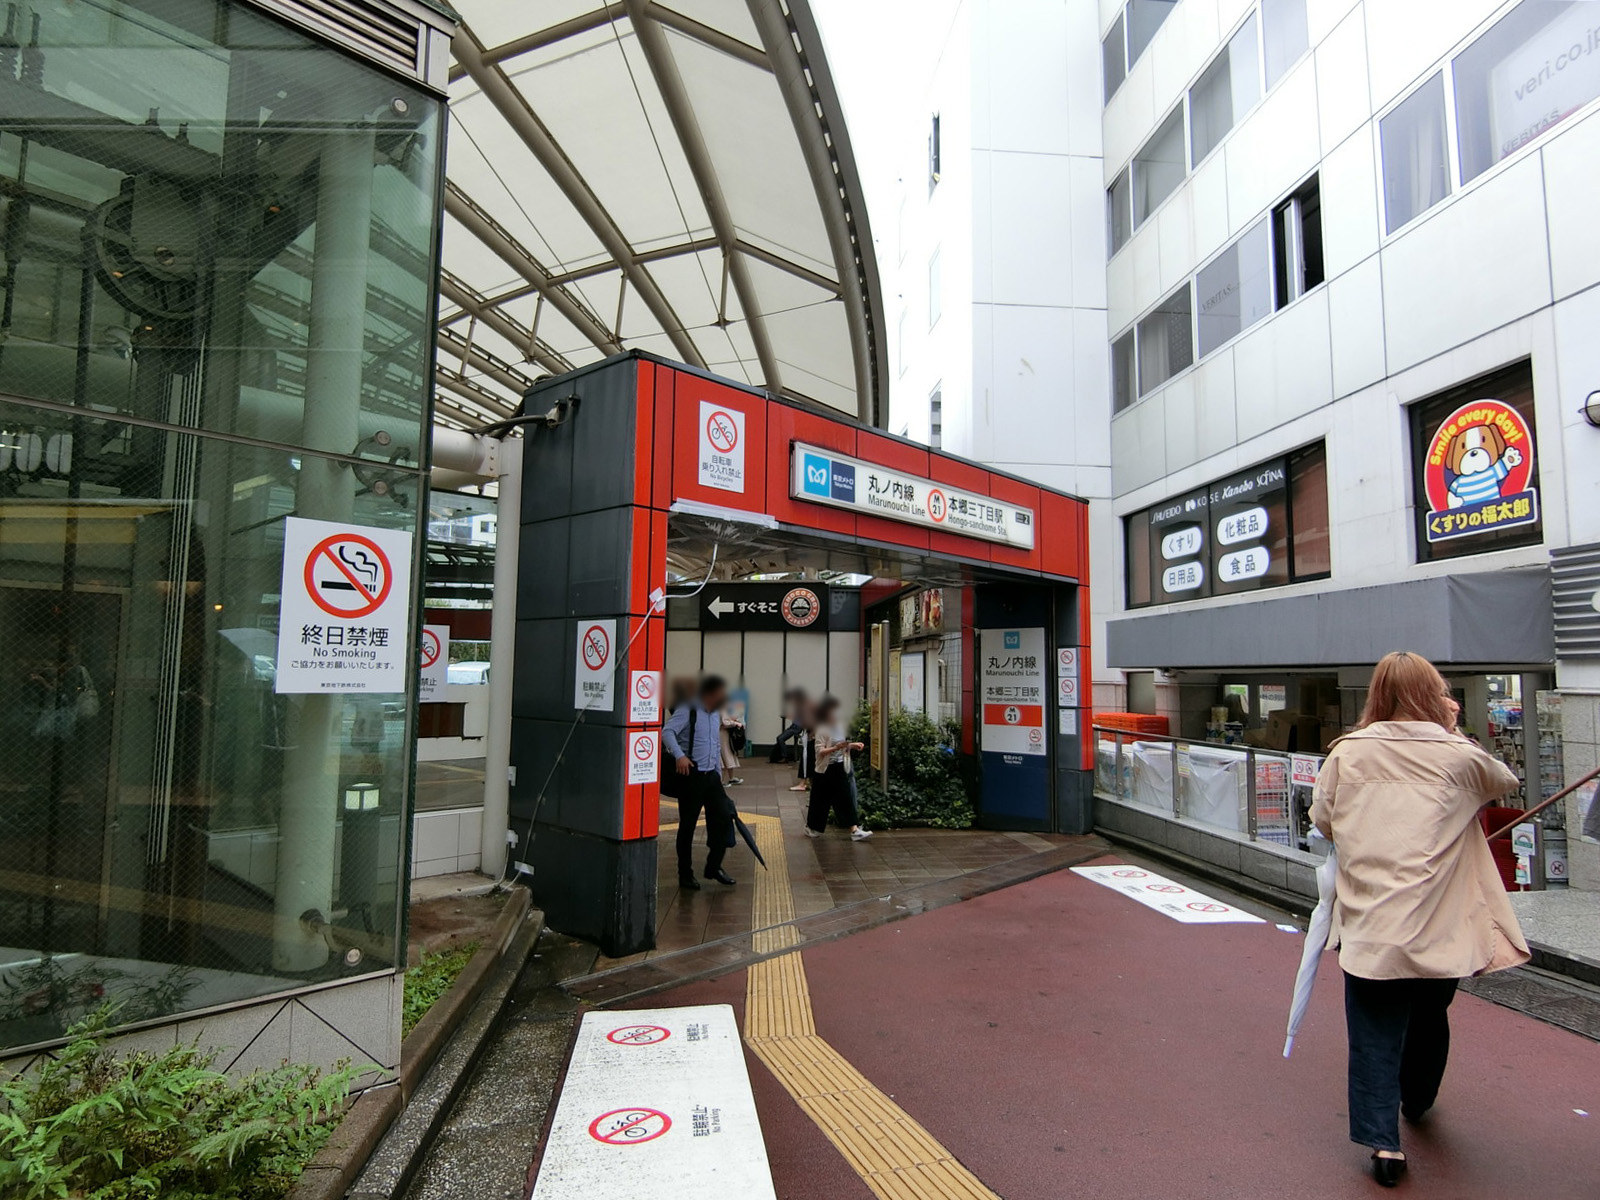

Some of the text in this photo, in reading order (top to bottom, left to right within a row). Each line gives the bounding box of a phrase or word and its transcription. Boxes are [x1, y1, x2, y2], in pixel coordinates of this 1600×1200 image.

[1502, 109, 1561, 155] VERITAS
[1430, 408, 1523, 466] Smile every day!
[712, 455, 732, 466] 自転車
[833, 474, 854, 485] 東京メトロ
[868, 474, 915, 501] 丸ノ内線
[868, 494, 926, 517] Marunouchi Line
[933, 494, 940, 504] M
[1151, 505, 1181, 524] SHISEIDO
[1222, 480, 1253, 500] Kanebo
[1256, 468, 1283, 488] SOFINA
[932, 505, 941, 515] 21
[948, 496, 1003, 524] 本郷三丁目駅
[1024, 515, 1028, 523] 2
[1430, 498, 1530, 534] くすりの福太郎
[948, 513, 996, 533] Hongo-sanchome
[1225, 514, 1259, 538] 化粧品
[1168, 533, 1194, 553] くすり
[1230, 554, 1255, 576] 食品
[1169, 567, 1195, 587] 日用品
[737, 602, 778, 613] すぐそこ
[301, 624, 389, 647] 終日禁煙
[313, 648, 376, 660] No Smoking
[988, 656, 1037, 669] 丸ノ内線
[291, 660, 394, 670] ご協力をお願いいたします。
[420, 677, 437, 686] 禁止
[583, 681, 606, 692] 駐輪禁止
[986, 687, 1039, 697] 本郷三丁目駅
[692, 1104, 710, 1137] 駐輪禁止
